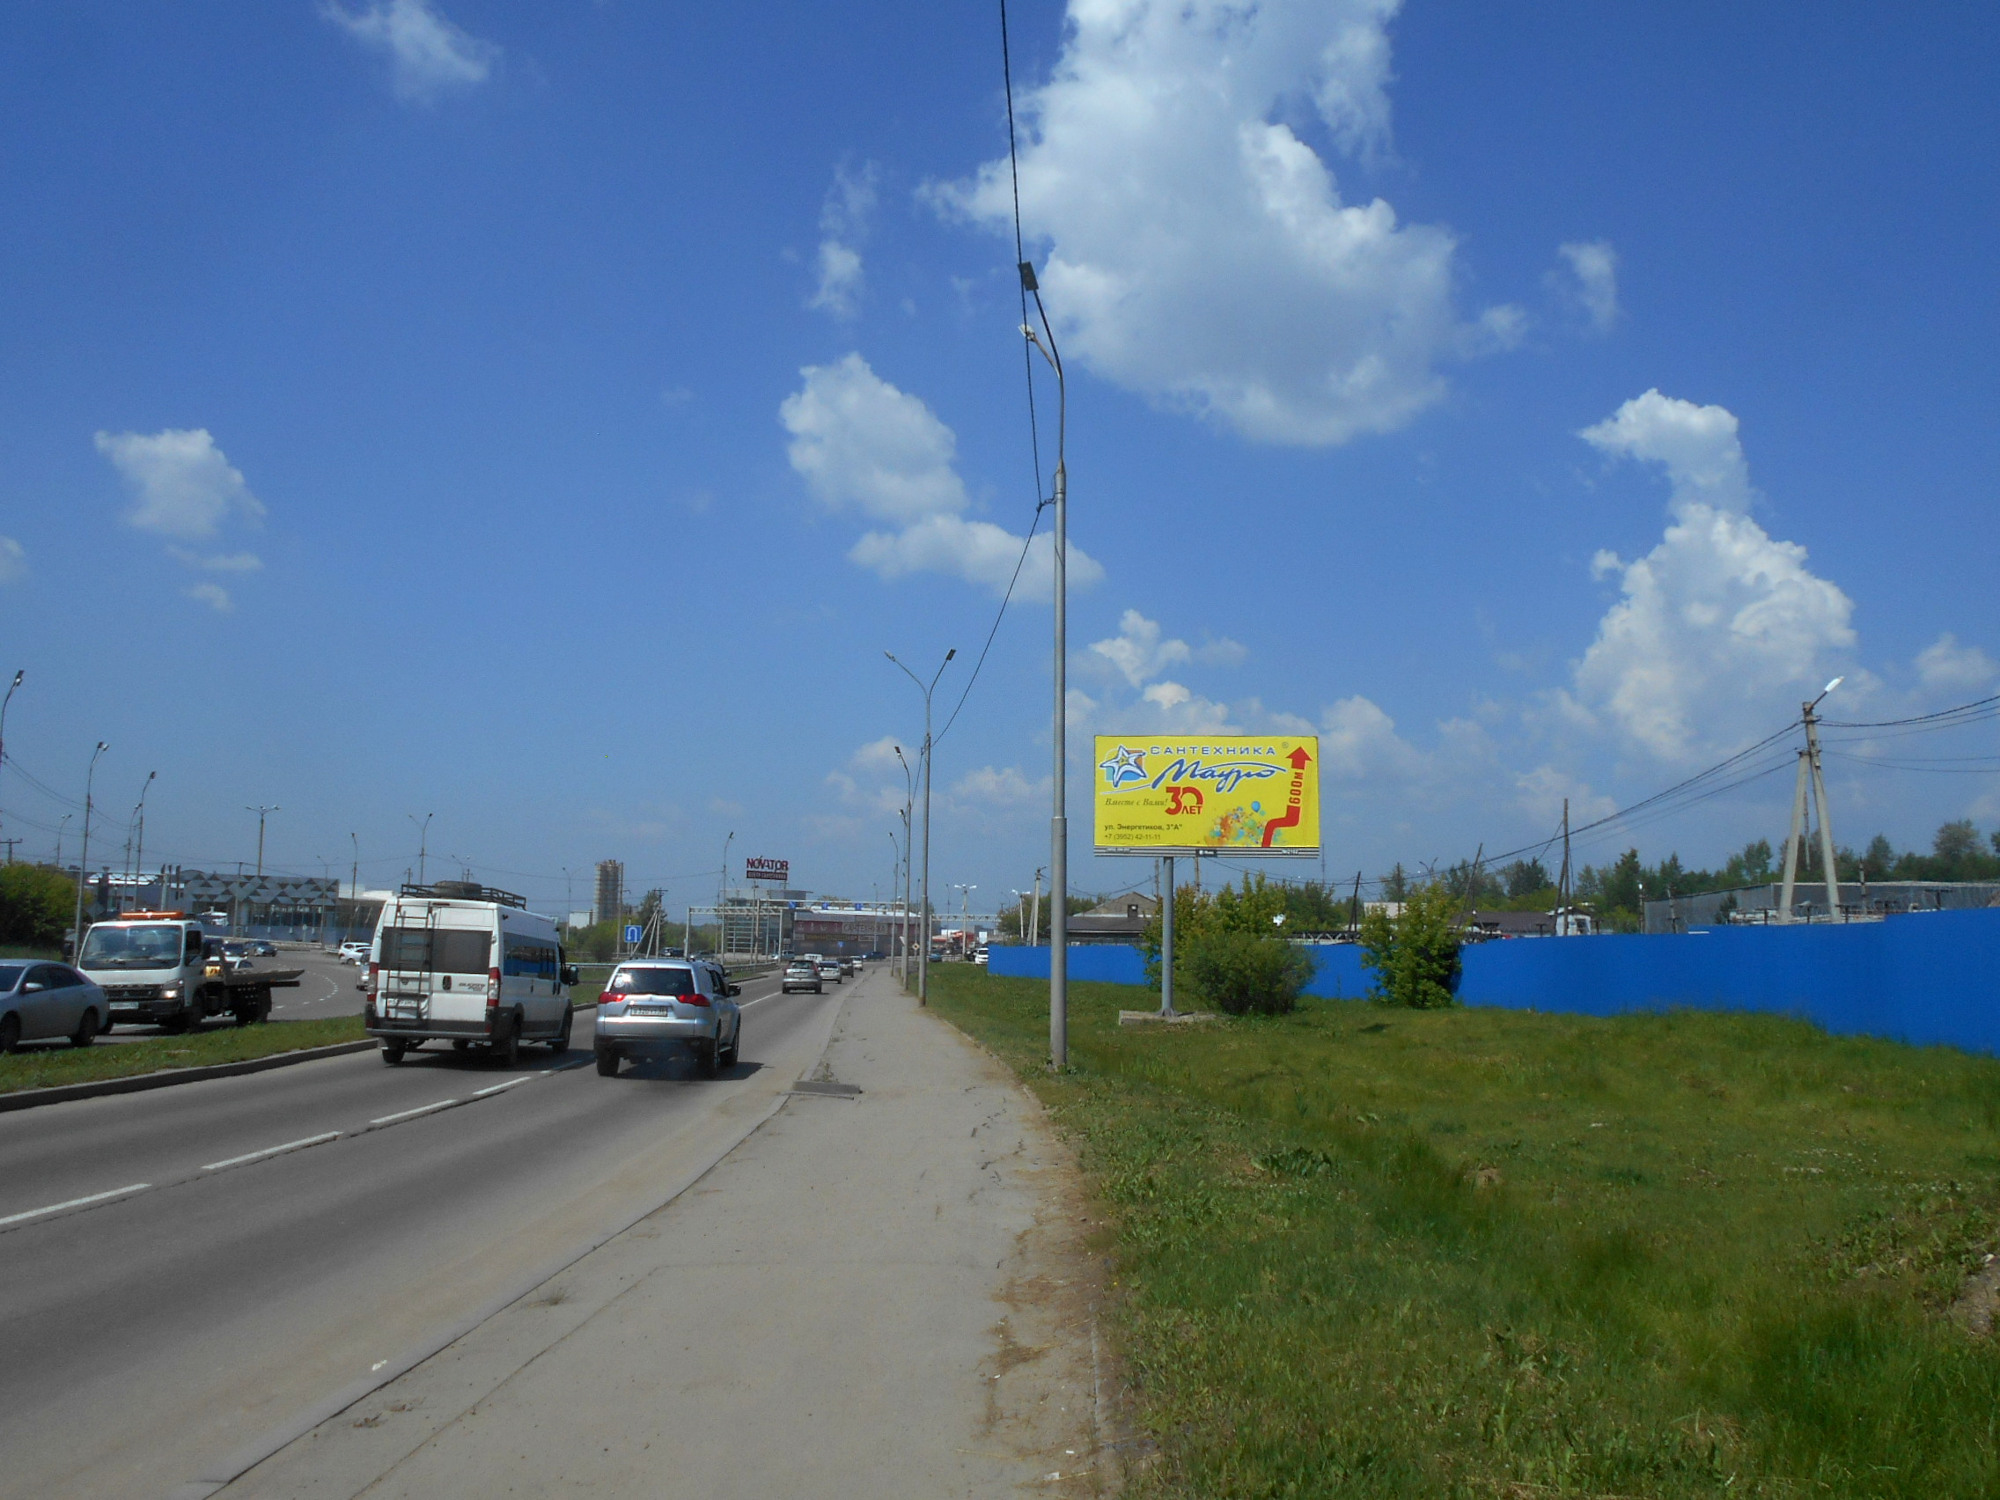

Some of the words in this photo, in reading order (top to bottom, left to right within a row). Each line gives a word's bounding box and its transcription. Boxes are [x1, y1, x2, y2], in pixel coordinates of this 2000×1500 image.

[1150, 746, 1276, 755] САНТЕХНИКА
[1151, 758, 1286, 793] Мауро
[1164, 786, 1204, 816] 30
[1181, 805, 1203, 815] ЛЕТ
